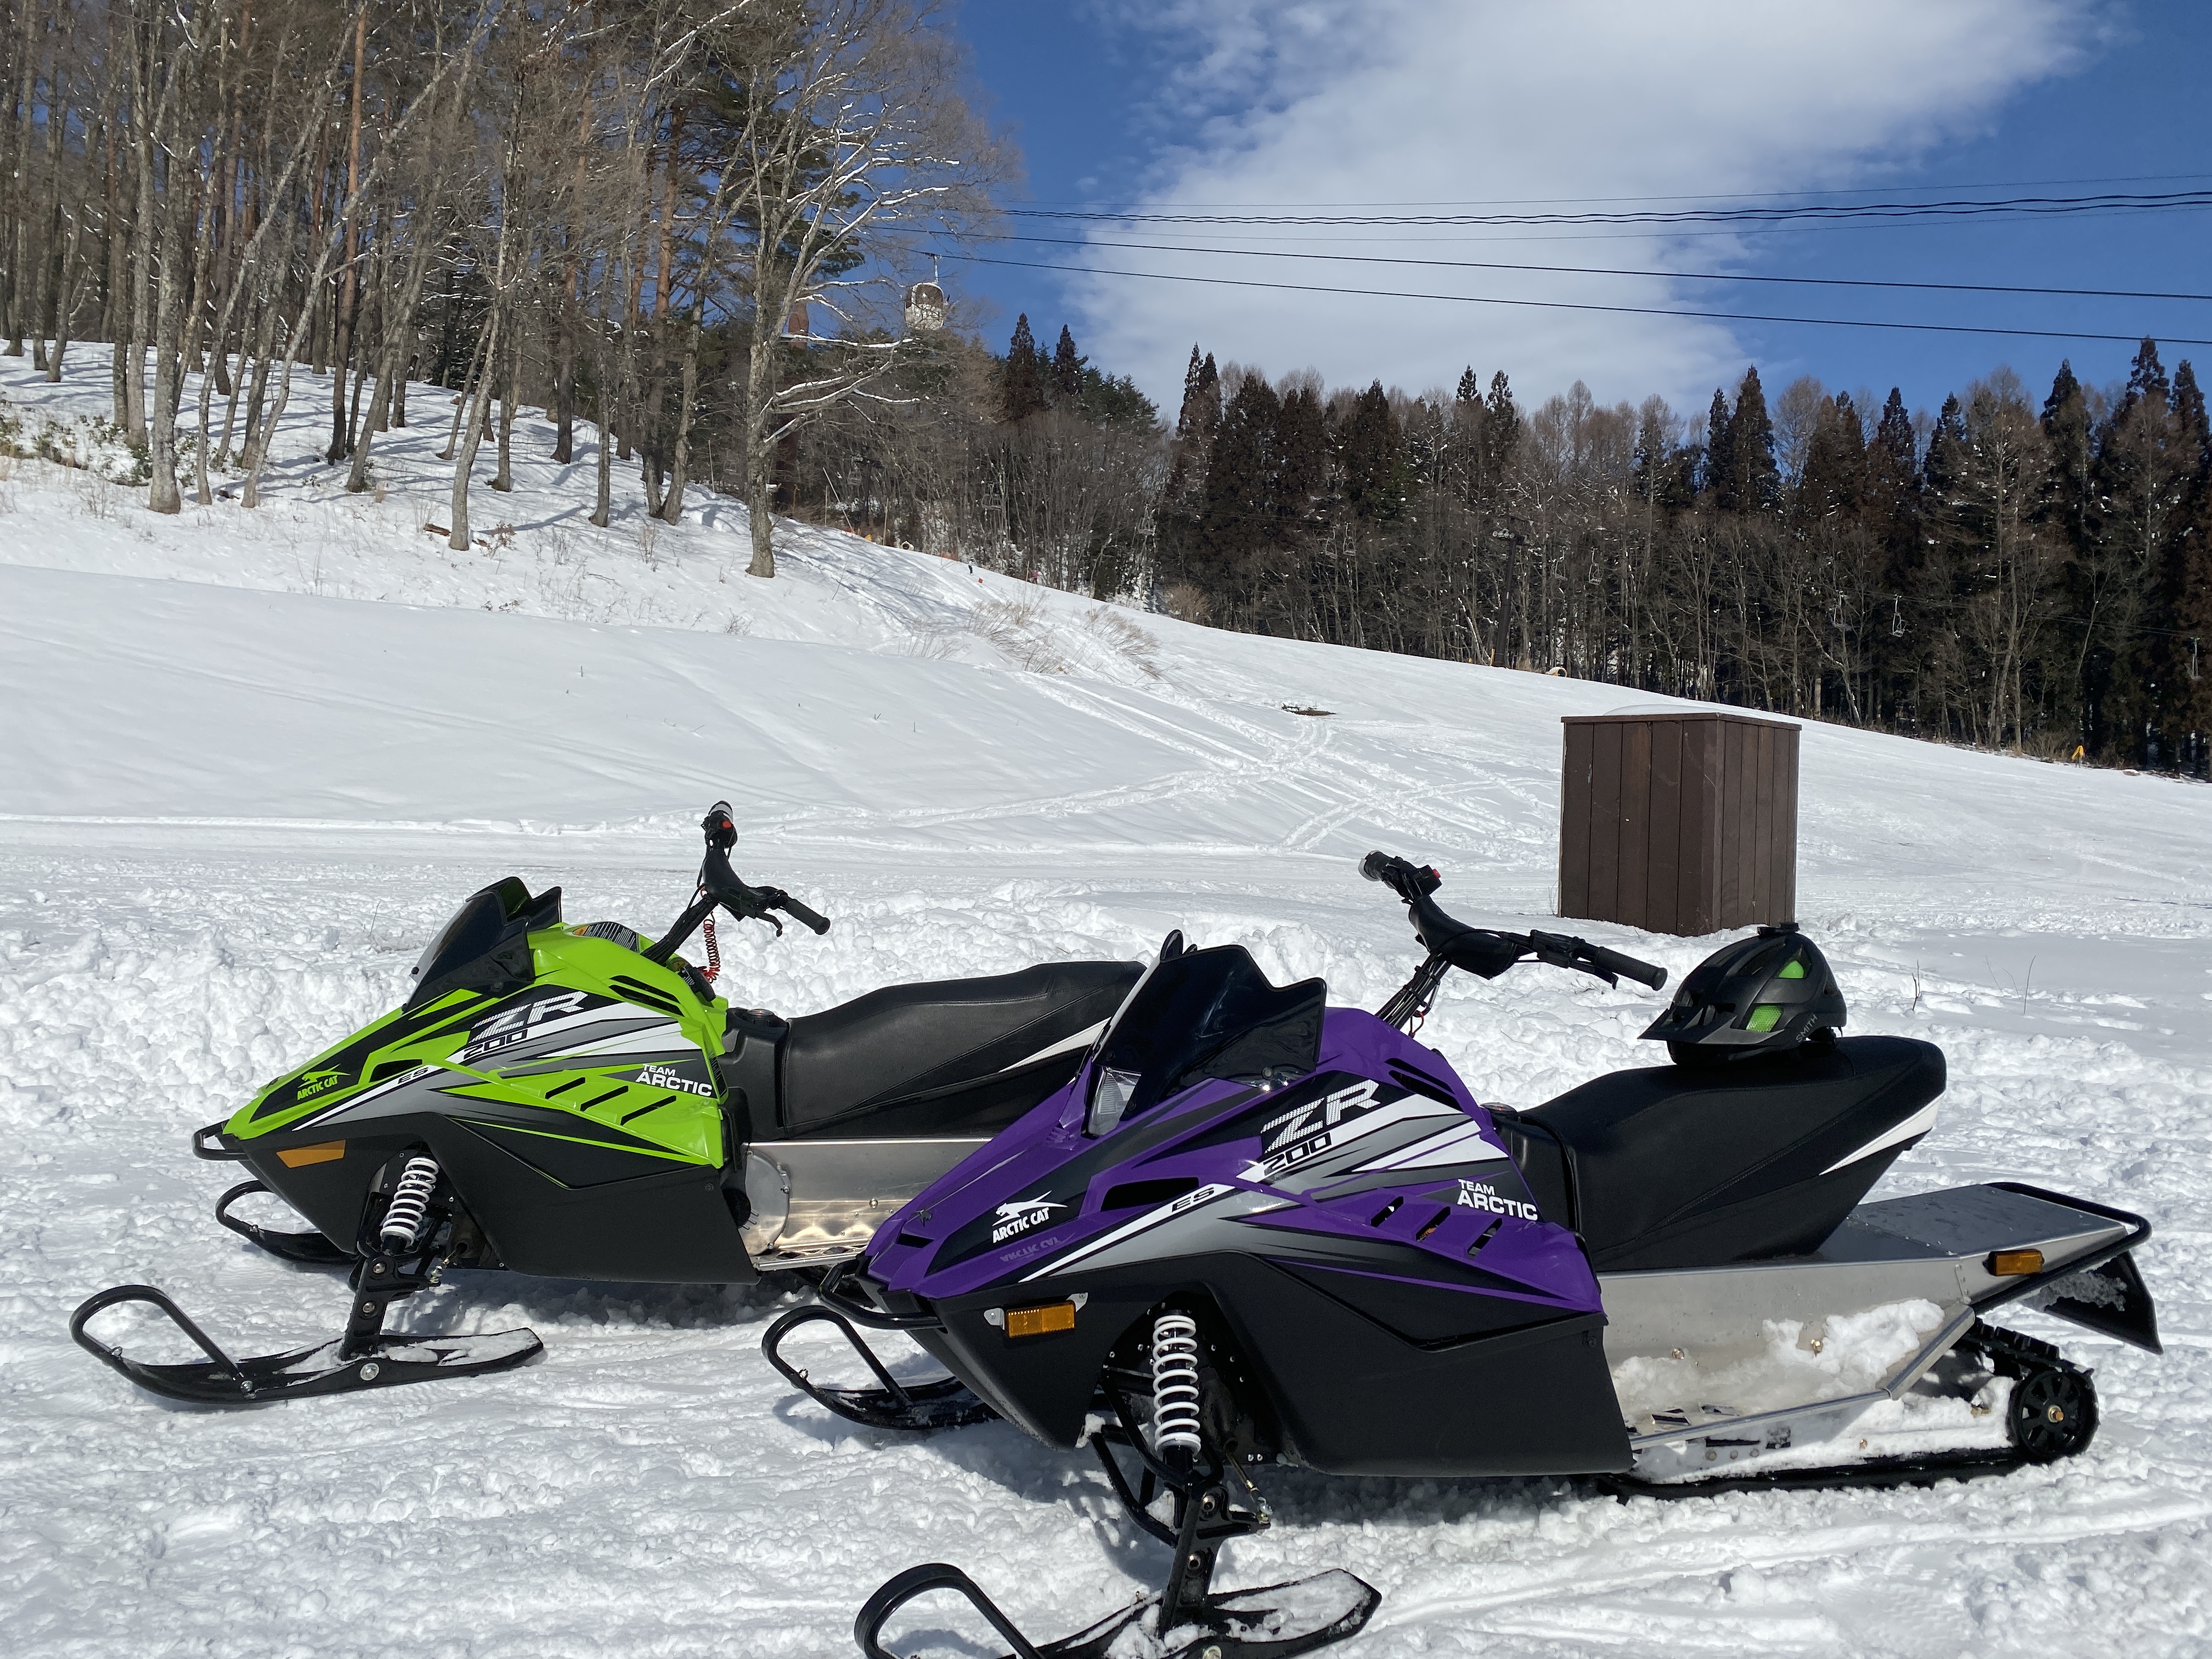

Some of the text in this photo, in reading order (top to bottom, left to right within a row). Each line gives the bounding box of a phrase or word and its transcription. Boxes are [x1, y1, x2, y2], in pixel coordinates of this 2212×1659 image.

[469, 991, 588, 1043] ZR
[1796, 1014, 1818, 1042] SMITH
[464, 1029, 528, 1060] 200
[397, 1066, 429, 1084] ES
[642, 1063, 676, 1076] TEAM
[297, 1075, 338, 1101] ARCTIC CAT
[635, 1071, 712, 1097] ARCTIC
[1260, 1079, 1381, 1153] ZR
[1263, 1132, 1332, 1176] 200
[1171, 1187, 1215, 1212] ES
[1458, 1178, 1496, 1196] TEAM
[1457, 1189, 1538, 1221] ARCTIC
[992, 1207, 1050, 1243] ARCTIC CAT
